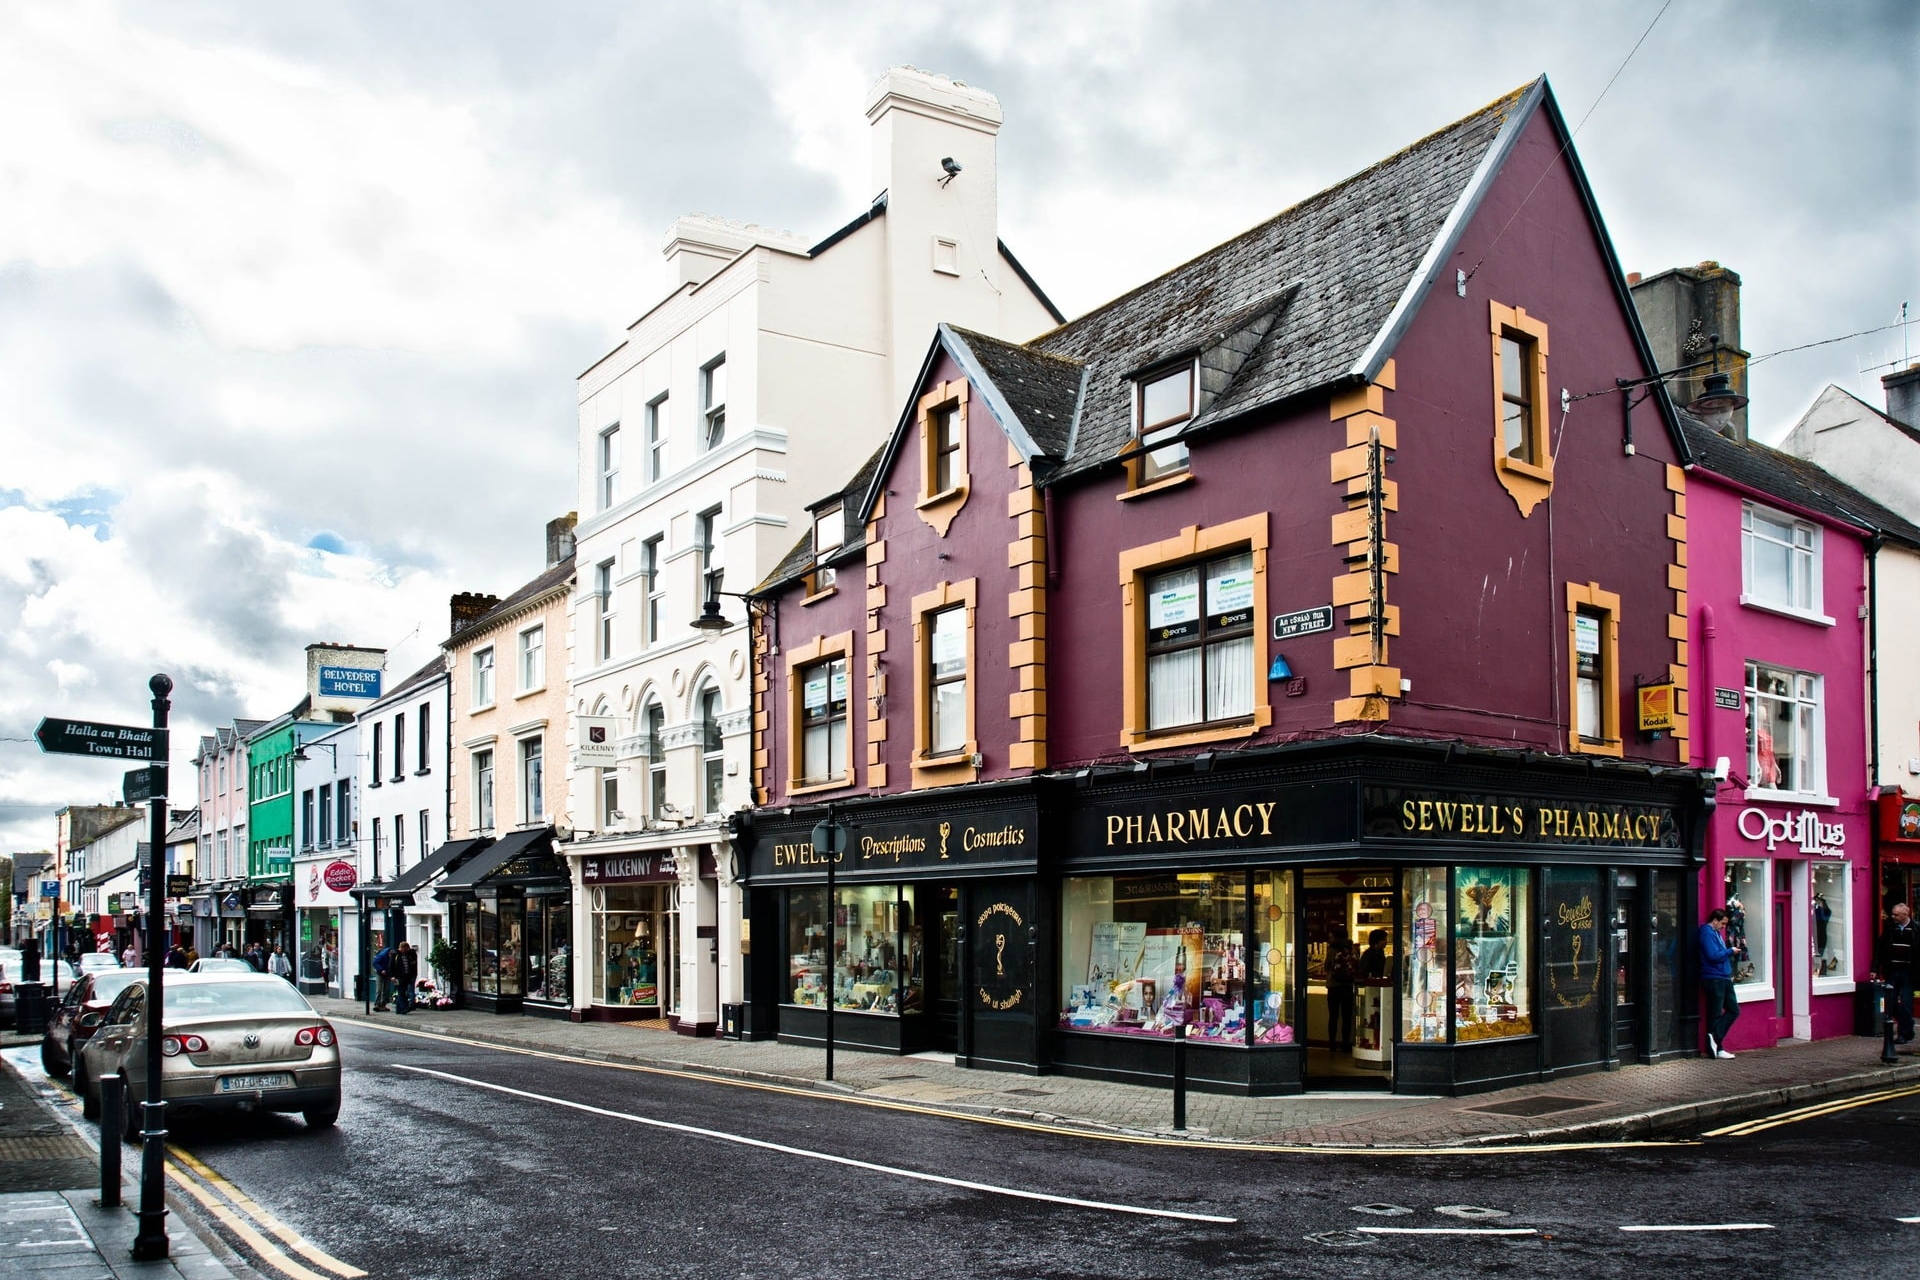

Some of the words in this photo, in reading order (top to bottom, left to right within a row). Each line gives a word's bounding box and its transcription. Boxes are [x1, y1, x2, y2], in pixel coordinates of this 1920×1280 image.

[1282, 624, 1298, 635] NEW
[1300, 620, 1325, 631] STREET
[324, 669, 377, 682] BELVEDERE
[334, 681, 367, 693] HOTEL
[1643, 716, 1668, 726] Kodak
[65, 724, 98, 737] Halla
[101, 730, 115, 739] an
[118, 729, 152, 742] Bhaile
[87, 741, 122, 755] Town
[126, 745, 152, 758] Hall
[580, 744, 615, 752] KILKENNY
[1106, 802, 1277, 846] PHARMACY
[1402, 800, 1524, 836] SEWELL'S
[1539, 808, 1661, 841] PHARMACY
[861, 835, 926, 863] Prescriptions
[963, 825, 1025, 853] Cosmetics
[330, 868, 351, 876] Eddie
[604, 856, 652, 877] KILKENNY
[326, 872, 356, 883] Rocket's
[46, 881, 56, 890] P
